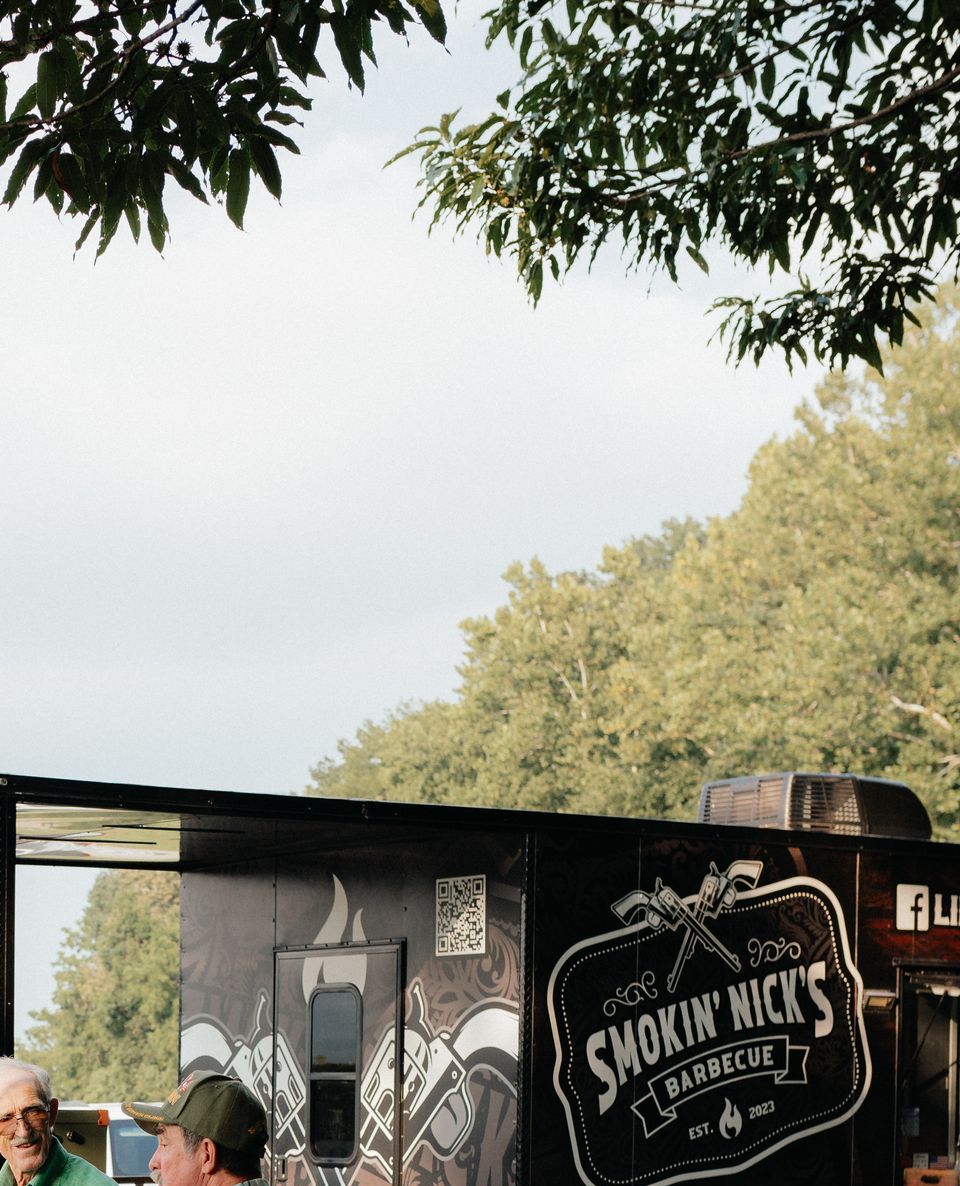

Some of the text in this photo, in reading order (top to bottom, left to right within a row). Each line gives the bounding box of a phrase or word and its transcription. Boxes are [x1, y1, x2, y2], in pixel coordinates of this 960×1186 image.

[933, 893, 960, 927] LI
[586, 961, 834, 1115] SMOKIN' NICK'S
[665, 1045, 775, 1100] BARBECUE
[688, 1100, 775, 1140] EST. 2023
